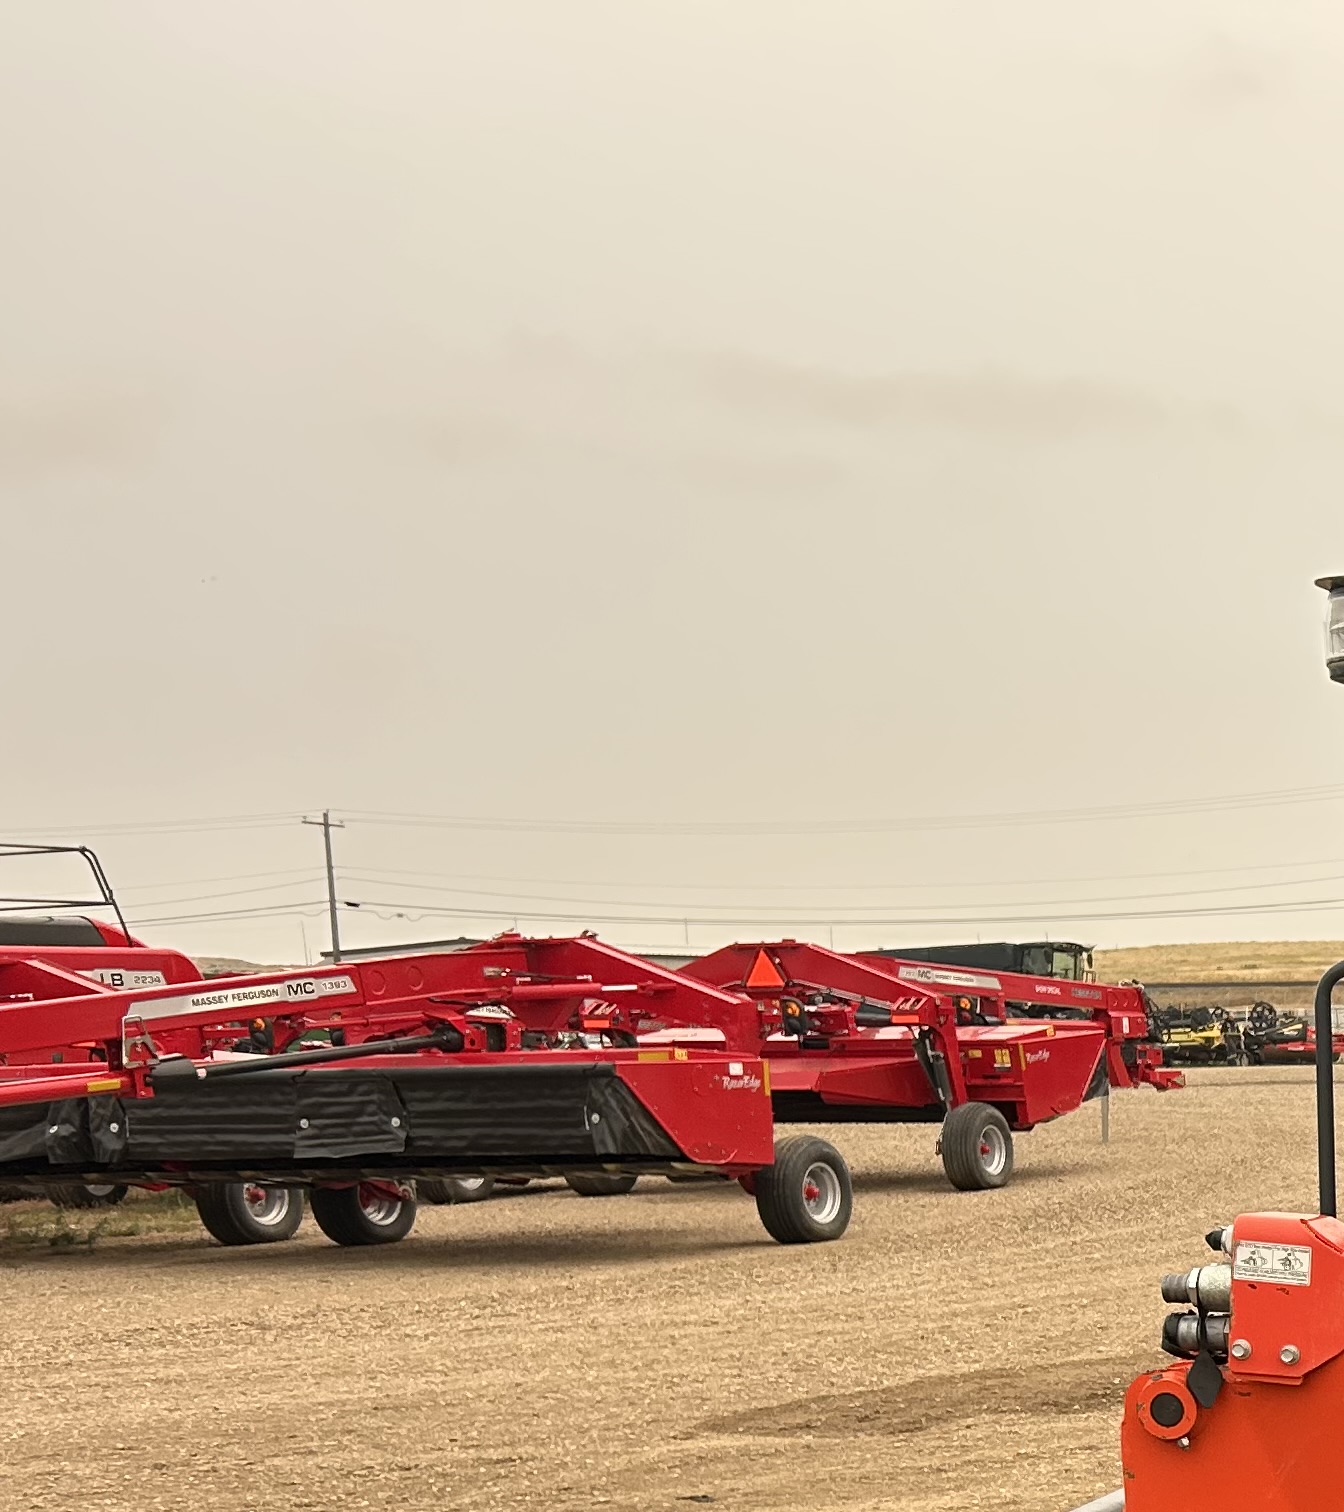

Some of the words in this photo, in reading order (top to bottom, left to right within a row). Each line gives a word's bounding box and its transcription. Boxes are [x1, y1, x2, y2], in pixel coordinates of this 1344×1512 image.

[191, 994, 228, 1006] MASSEY
[232, 988, 279, 1002] FERGUSON
[286, 982, 315, 996] MC
